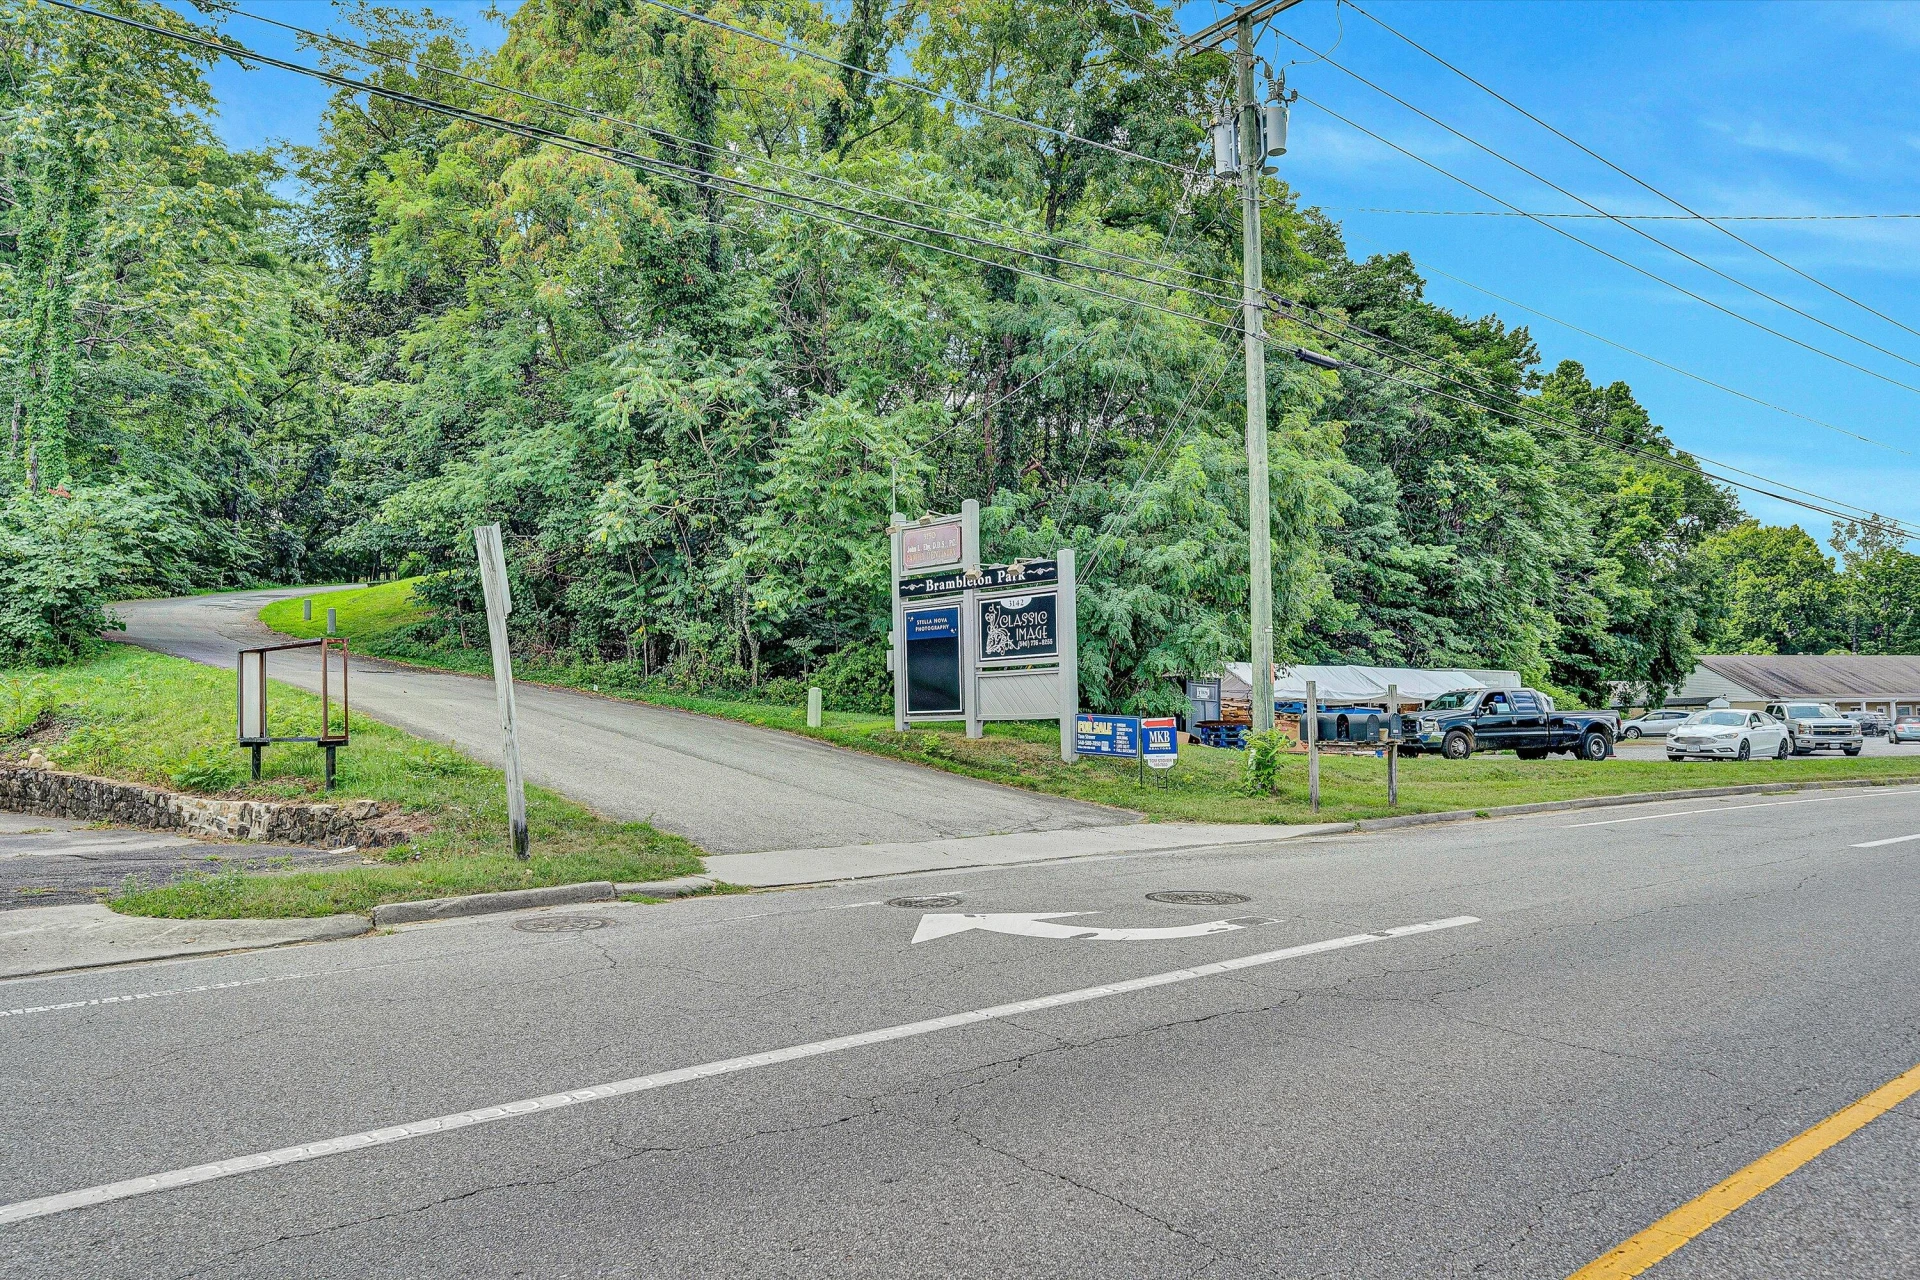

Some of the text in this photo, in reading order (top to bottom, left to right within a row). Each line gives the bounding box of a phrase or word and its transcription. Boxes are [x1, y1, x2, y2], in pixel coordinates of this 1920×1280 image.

[997, 570, 1026, 583] Park
[1008, 599, 1024, 607] 3142
[1000, 610, 1048, 628] CLASSIC
[916, 624, 950, 632] PHOTOGRAPHY
[1016, 626, 1048, 640] IMAGE
[1078, 720, 1112, 735] FOR SALE
[1148, 730, 1170, 743] MKB
